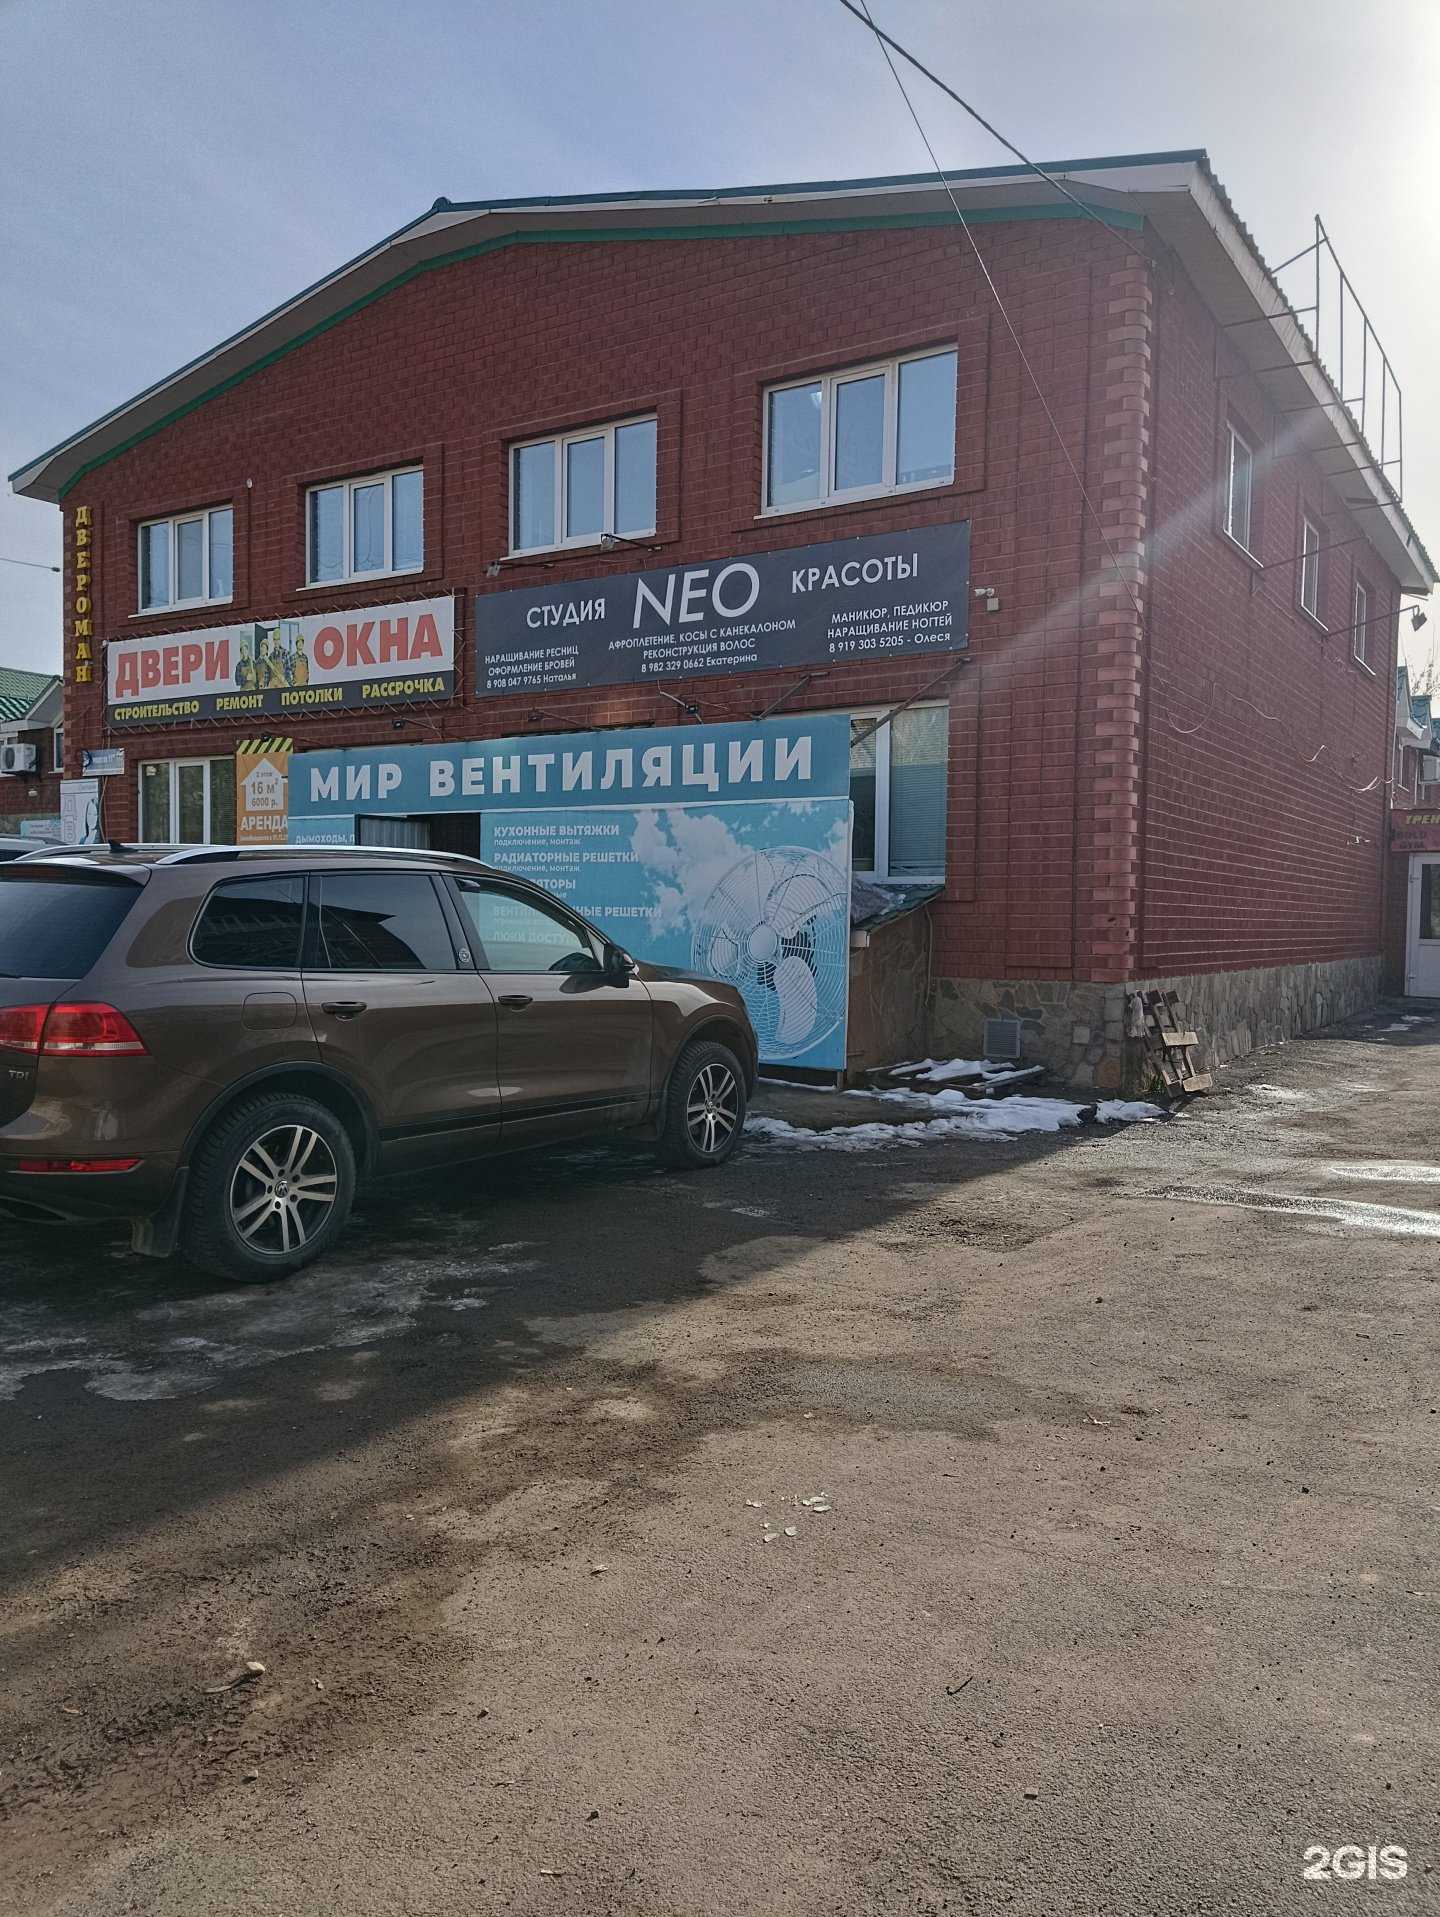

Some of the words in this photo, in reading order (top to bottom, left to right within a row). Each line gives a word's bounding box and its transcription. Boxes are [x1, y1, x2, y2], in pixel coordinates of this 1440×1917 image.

[75, 505, 93, 683] ДВЕРОМАН
[526, 598, 605, 628] СТУДИЯ
[632, 562, 760, 628] NEO
[791, 553, 918, 594] КРАСОТЫ
[831, 608, 890, 624] МАНИКЮР,
[893, 600, 949, 617] ПЕДИКЮР
[608, 635, 677, 650] АФРОПЛЕТЕНИЕ,
[679, 631, 708, 643] КОСЫ
[719, 619, 796, 638] КАНЕКАЛОНОМ
[827, 620, 909, 638] НАРАЩИВАНИЕ
[911, 613, 953, 630] НОГТЕЙ
[643, 643, 718, 660] РЕКОНСТРУКЦИЯ
[720, 638, 756, 651] ВОЛОС
[829, 643, 835, 653] 8
[838, 640, 856, 652] 919
[859, 639, 877, 650] 303
[879, 635, 904, 648] 5205
[914, 633, 951, 645] Олеся
[115, 639, 230, 698] ДВЕРИ
[313, 613, 443, 670] ОКНА
[485, 649, 545, 665] НАРАЩИВАНИЕ
[546, 645, 579, 658] РЕСНИЦ
[641, 664, 647, 673] 8
[649, 663, 665, 673] 982
[666, 661, 682, 671] 329
[683, 658, 704, 669] 0662
[706, 654, 758, 667] Екатерина
[488, 662, 543, 677] ОФОРМЛЕНИЕ
[544, 656, 575, 671] БРОВЕЙ
[486, 680, 492, 689] 8
[543, 673, 577, 683] Наталья
[114, 700, 200, 721] СТРОИТЕЛЬСТВО
[216, 694, 264, 711] РЕМОНТ
[281, 687, 343, 706] ПОТОЛКИ
[362, 677, 445, 699] РАССРОЧКА
[310, 763, 402, 802] МИР
[429, 736, 812, 797] ВЕНТИЛЯЦИИ
[241, 815, 288, 832] АРЕНДА
[494, 826, 556, 837] КУХОННЫЕ
[559, 825, 620, 836] ВЫТЯЖКИ
[494, 852, 580, 864] РАДИАТОРНЫЕ
[582, 851, 640, 863] РЕШЕТКИ
[604, 905, 662, 917] РЕШЕТКИ
